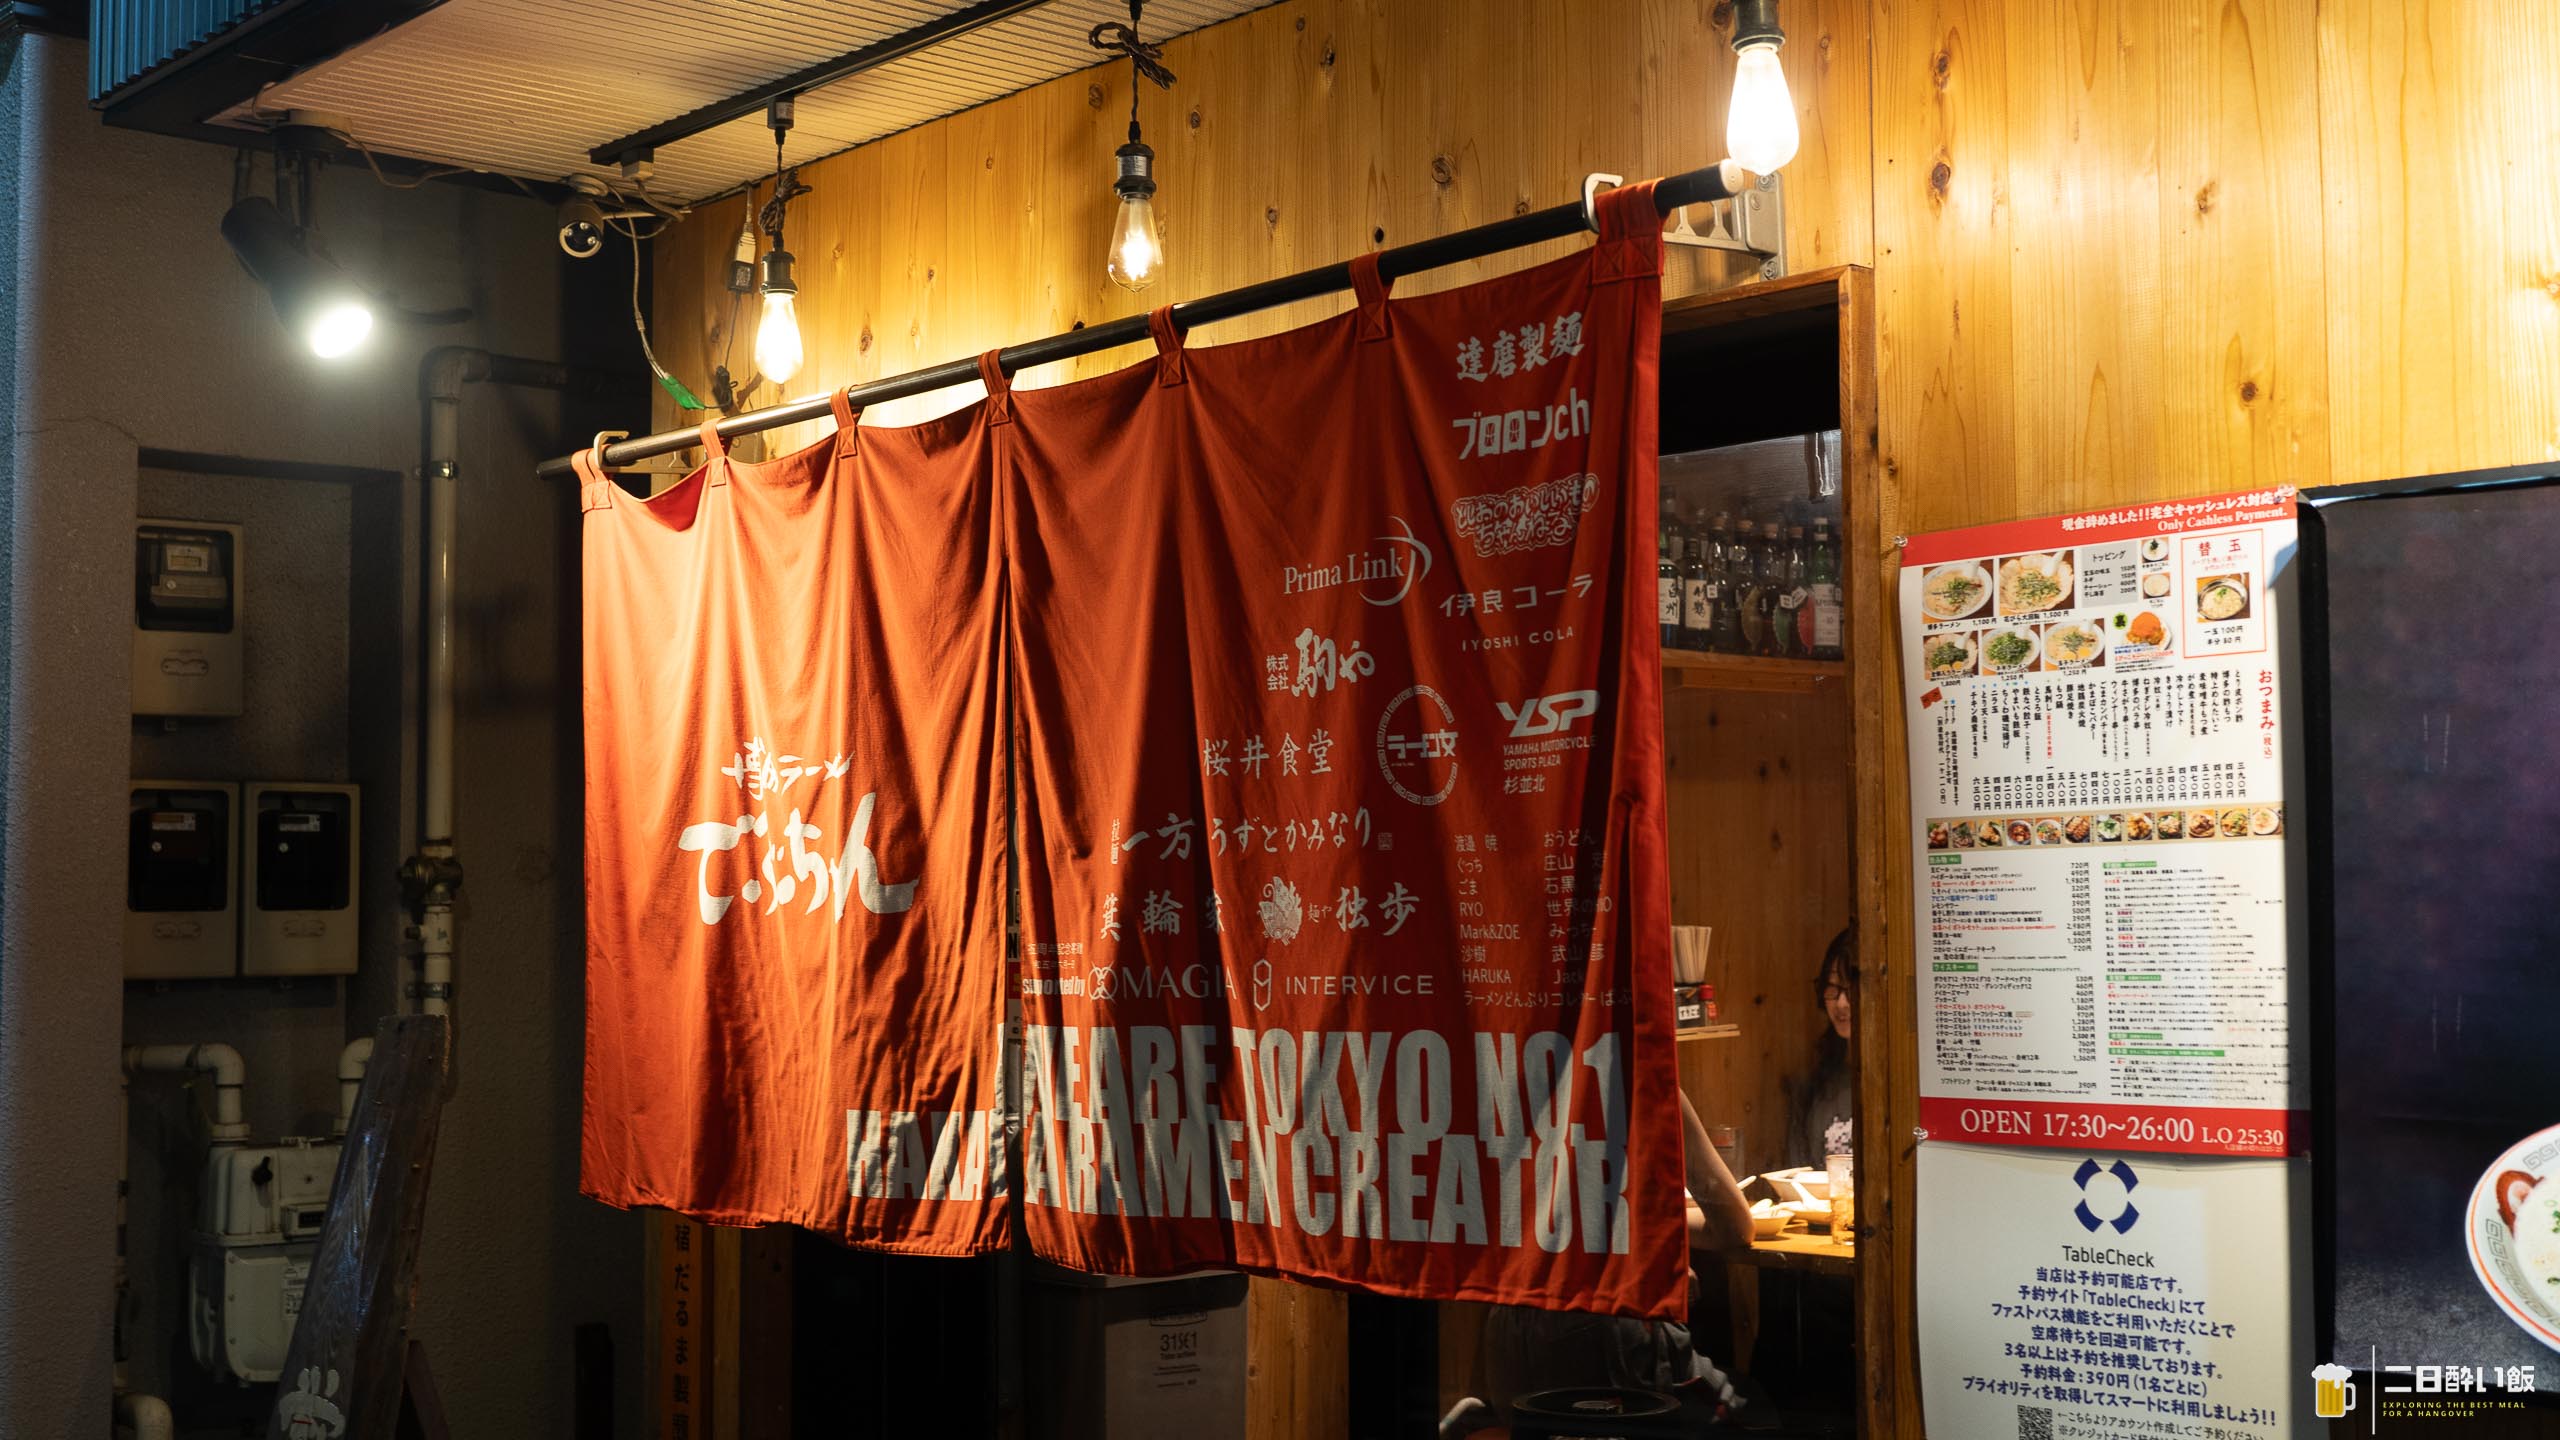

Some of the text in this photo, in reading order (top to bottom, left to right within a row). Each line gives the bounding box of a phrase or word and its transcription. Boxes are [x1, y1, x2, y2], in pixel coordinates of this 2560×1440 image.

[2158, 507, 2288, 533] Only Cashless Payment.
[2092, 550, 2126, 562] トッピング
[1284, 548, 1405, 594] Prima Link
[1461, 626, 1574, 652] IYOSHI COLA
[1496, 690, 1599, 737] YSP
[2258, 670, 2276, 730] おつまみ
[1203, 729, 1335, 779] 桜井食堂
[1503, 736, 1597, 756] YAMAHA MOTORCYCLE
[1503, 756, 1561, 770] SPORTS PLAZA
[1211, 806, 1370, 857] うずとかみなり
[1458, 879, 1478, 895] ごま
[1336, 882, 1420, 936] 独歩
[1460, 902, 1483, 916] RYO
[1460, 924, 1520, 940] Mark&ZOE
[1286, 975, 1434, 995] INTERVICE
[1463, 968, 1512, 984] HARUKA
[1233, 1027, 1452, 1142] TOKYO
[1960, 1108, 2032, 1135] OPEN
[2202, 1126, 2233, 1143] L.O
[2237, 1129, 2284, 1146] 25:30
[1291, 1125, 1630, 1256] CREATOR
[2062, 1245, 2155, 1268] TableCheck
[2035, 1267, 2184, 1294] 当店は予約可能店です。
[1991, 1303, 2236, 1339] ファストパス機能をご利用いただくことで
[2031, 1325, 2193, 1355] 空席待ちを回避可能です。
